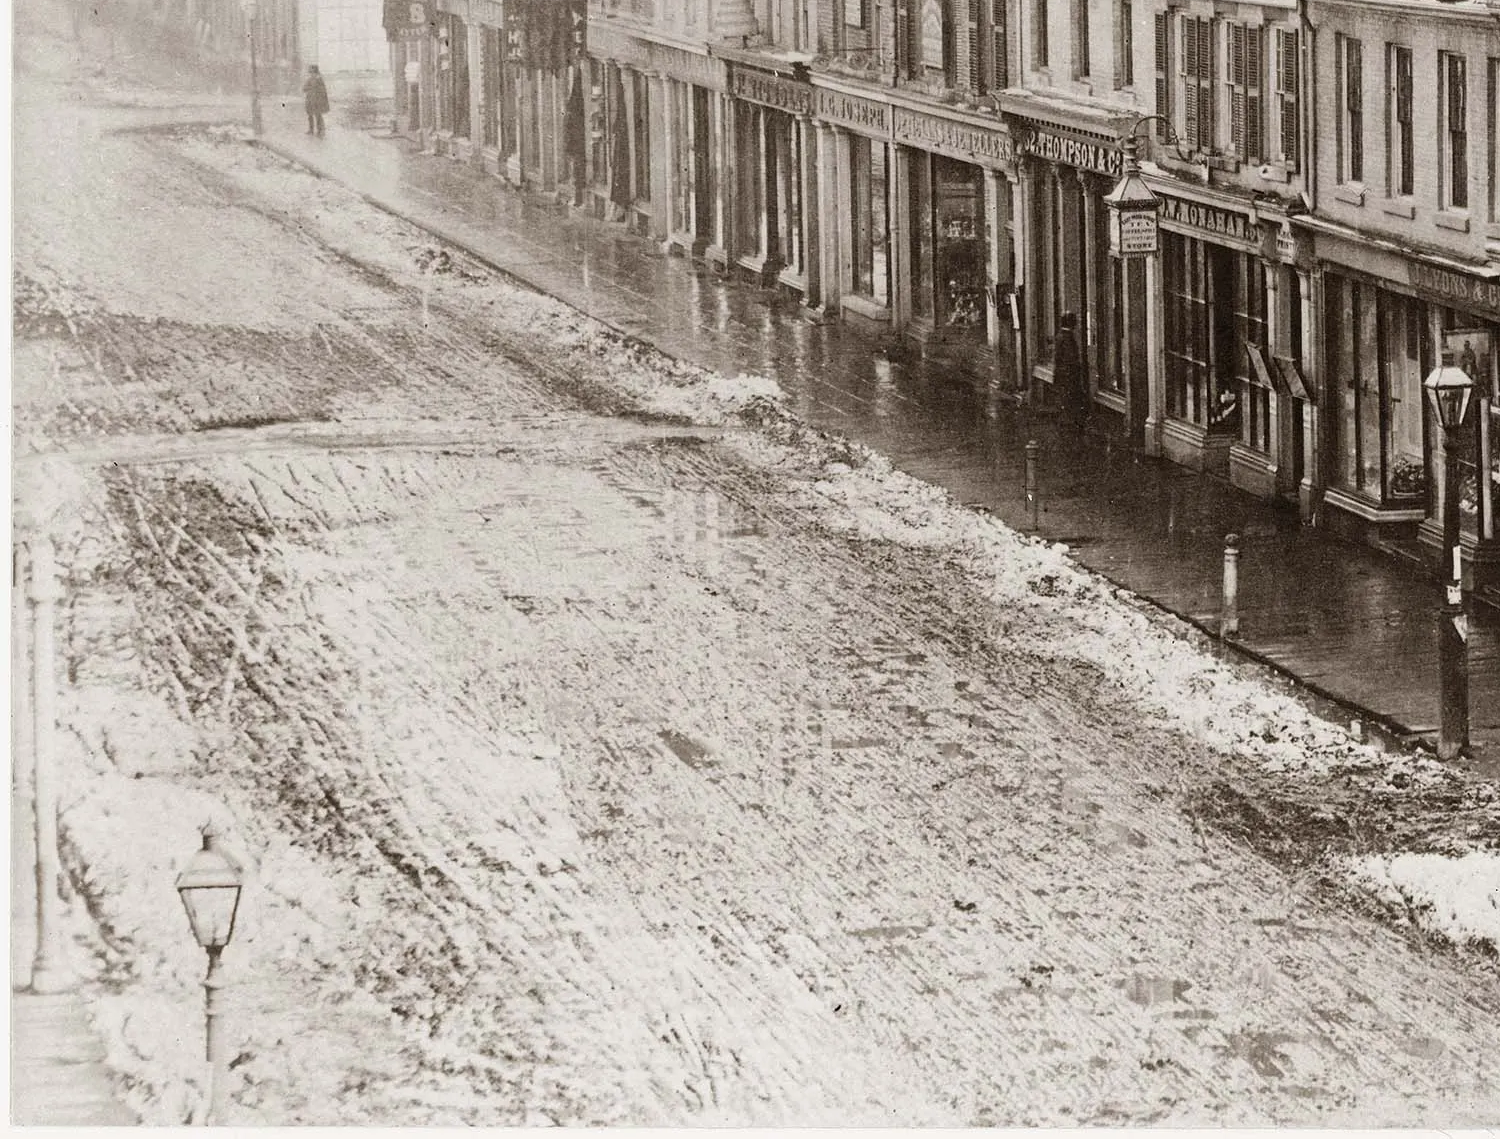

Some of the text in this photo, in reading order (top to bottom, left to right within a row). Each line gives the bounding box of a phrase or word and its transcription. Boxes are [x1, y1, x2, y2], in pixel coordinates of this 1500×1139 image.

[1039, 132, 1096, 169] THOMPSON
[1097, 148, 1106, 171] &
[1473, 279, 1485, 302] &
